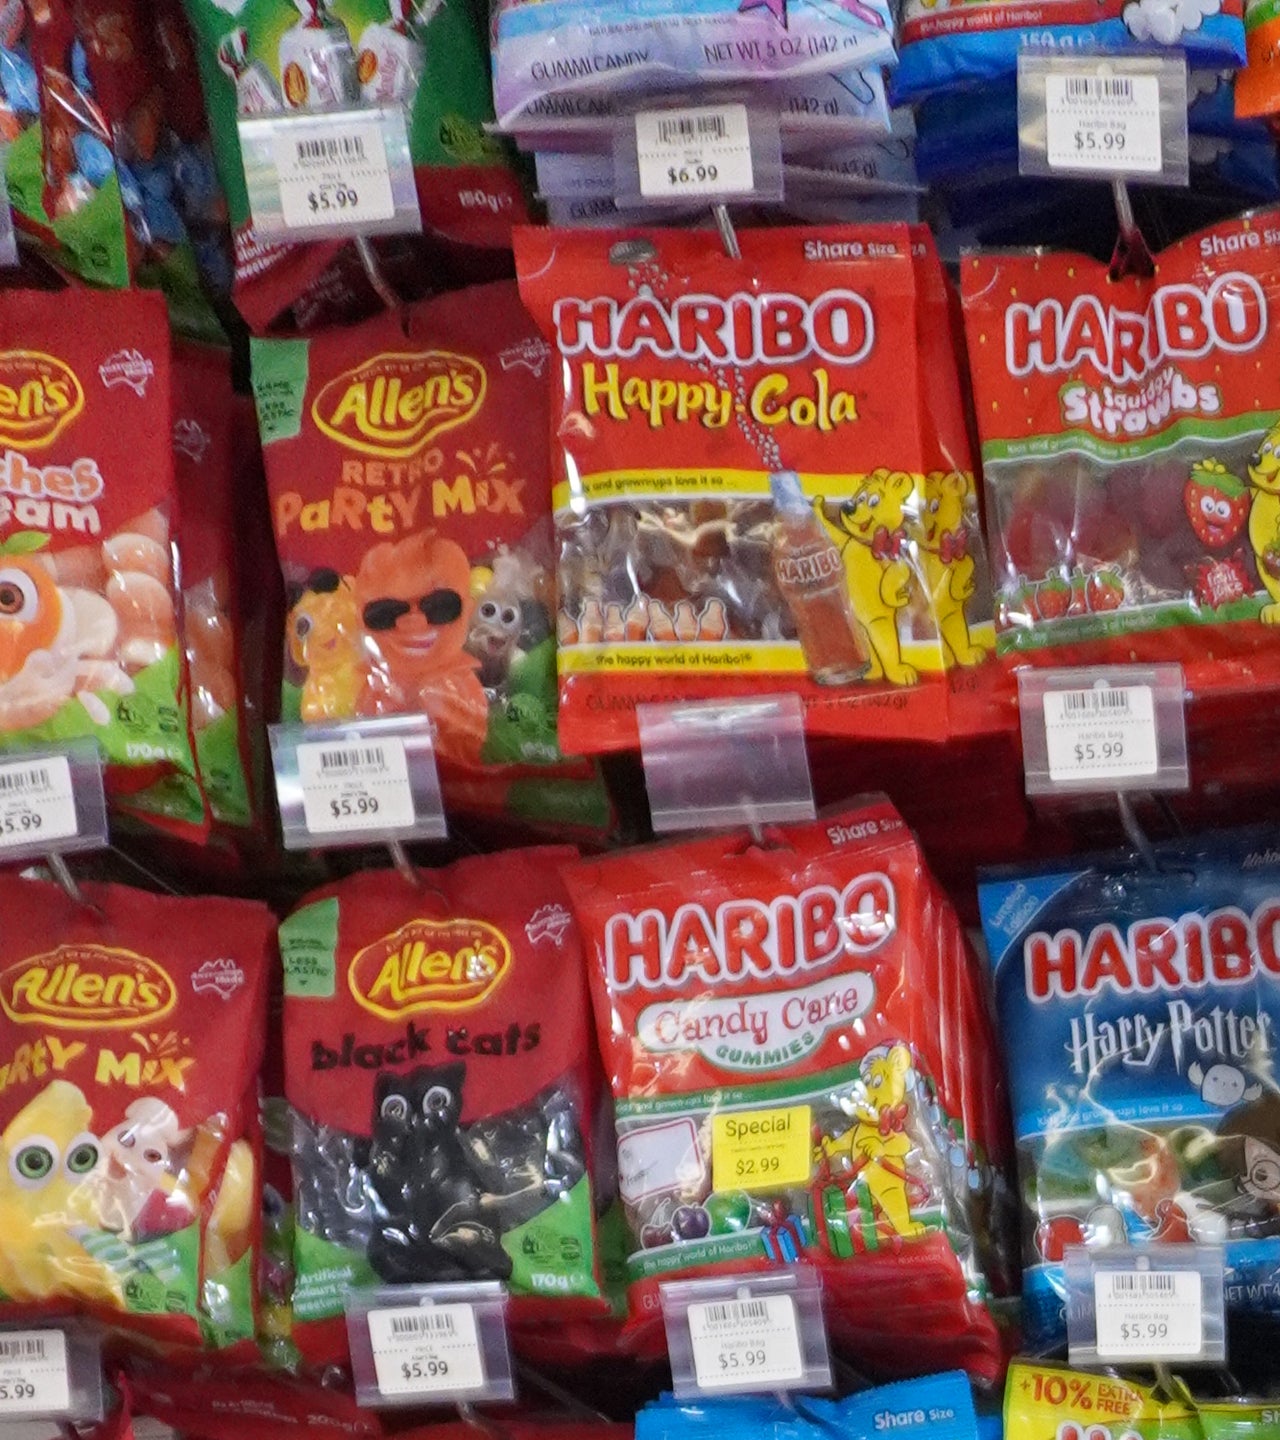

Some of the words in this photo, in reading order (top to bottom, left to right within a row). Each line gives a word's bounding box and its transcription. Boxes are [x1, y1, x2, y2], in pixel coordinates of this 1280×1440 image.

[1074, 131, 1126, 151] $5.99
[307, 188, 359, 211] $5.99
[1199, 232, 1258, 253] Share
[553, 288, 874, 364] HARIBO
[338, 373, 477, 427] Allen's
[584, 364, 731, 427] Happy
[750, 371, 858, 430] Cola
[605, 873, 896, 992] HARIBO
[654, 1006, 771, 1048] Candy
[782, 987, 859, 1031] Cane
[311, 1025, 430, 1073] black
[446, 1020, 541, 1057] cats
[715, 1032, 816, 1070] GUMMIES
[1066, 1006, 1164, 1073] Harry
[1169, 1003, 1271, 1064] Potter
[726, 1114, 792, 1141] Special
[735, 1157, 781, 1177] $2.99
[1121, 1320, 1168, 1341] $5.99
[1020, 1374, 1093, 1414] +10%
[1097, 1400, 1130, 1416] FREE
